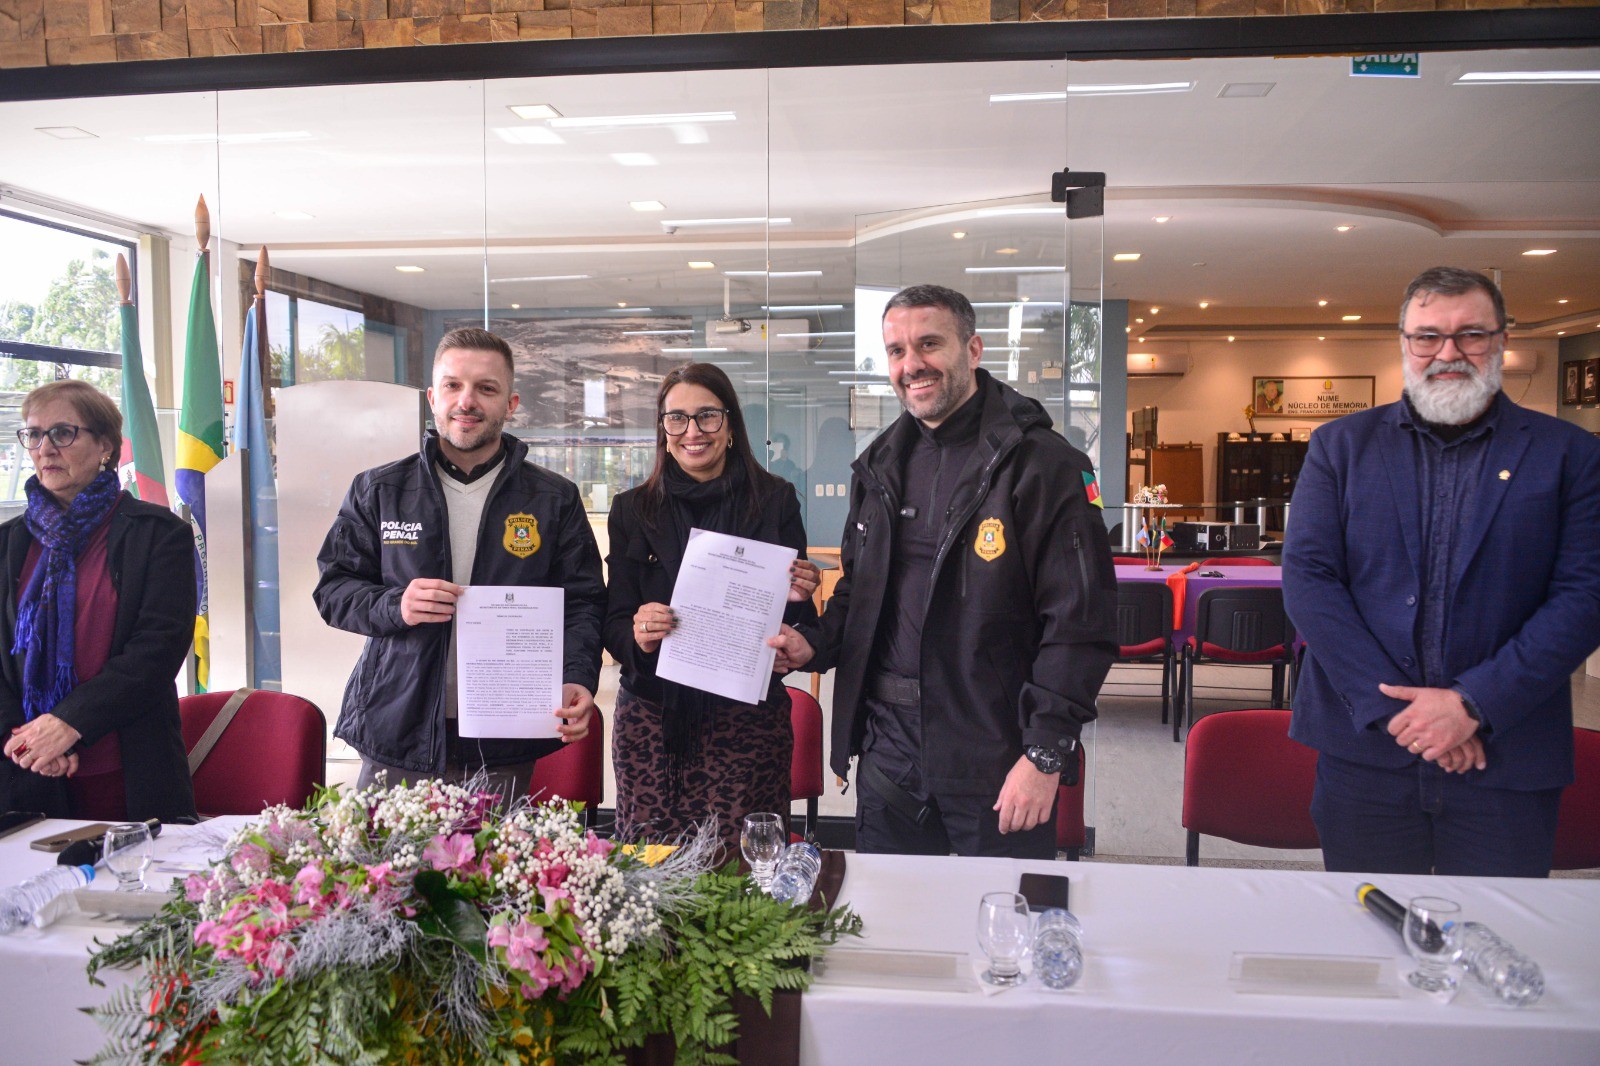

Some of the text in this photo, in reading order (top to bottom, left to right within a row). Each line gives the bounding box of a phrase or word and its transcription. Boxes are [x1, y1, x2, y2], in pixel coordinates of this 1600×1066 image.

[1287, 401, 1319, 409] NÚCLEO
[1332, 401, 1368, 409] MEMÓRIA
[382, 531, 419, 540] PENAL
